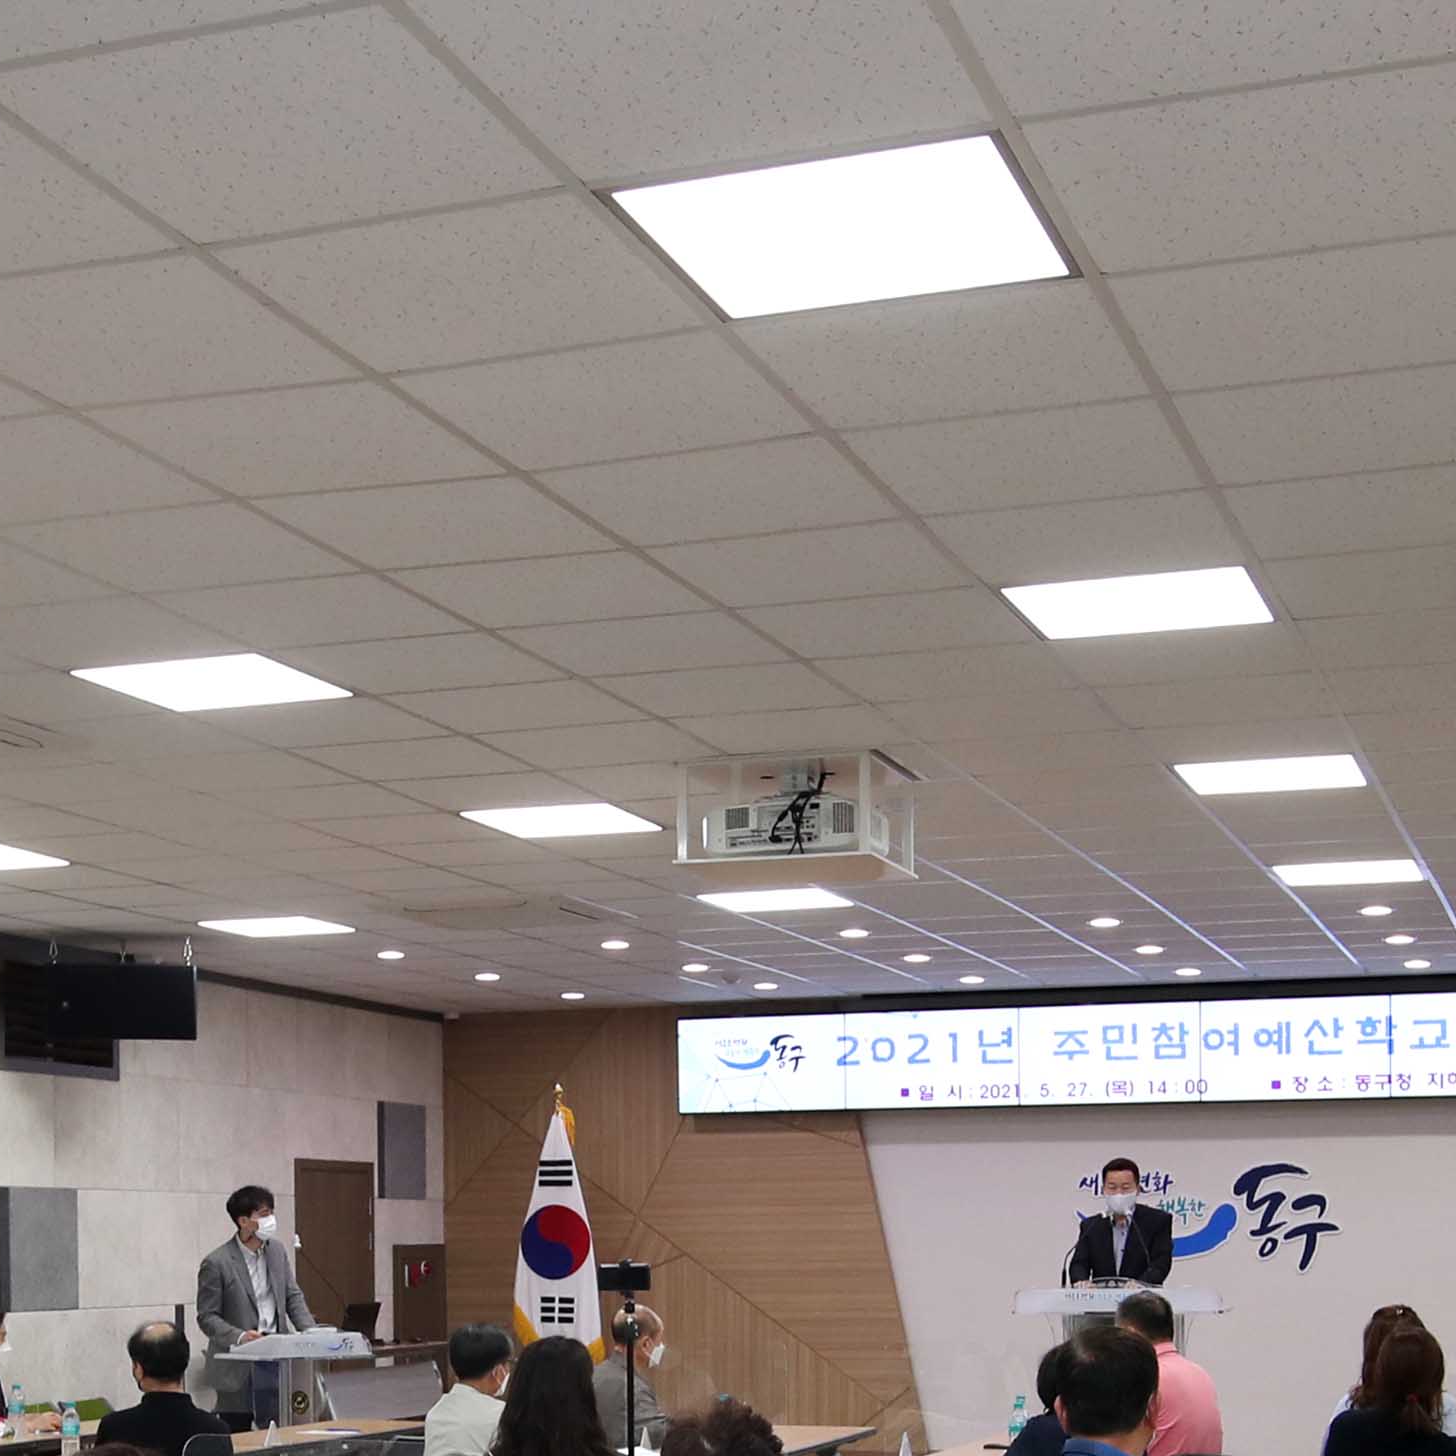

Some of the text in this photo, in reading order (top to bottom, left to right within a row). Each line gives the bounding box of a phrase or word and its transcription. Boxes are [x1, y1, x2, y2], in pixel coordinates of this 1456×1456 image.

[836, 1026, 1013, 1067] 2021년
[1053, 1016, 1451, 1061] 주민참여예산학교
[1104, 1080, 1134, 1097] (목)
[1354, 1072, 1412, 1092] 동구청
[1233, 1163, 1339, 1271] 동구
